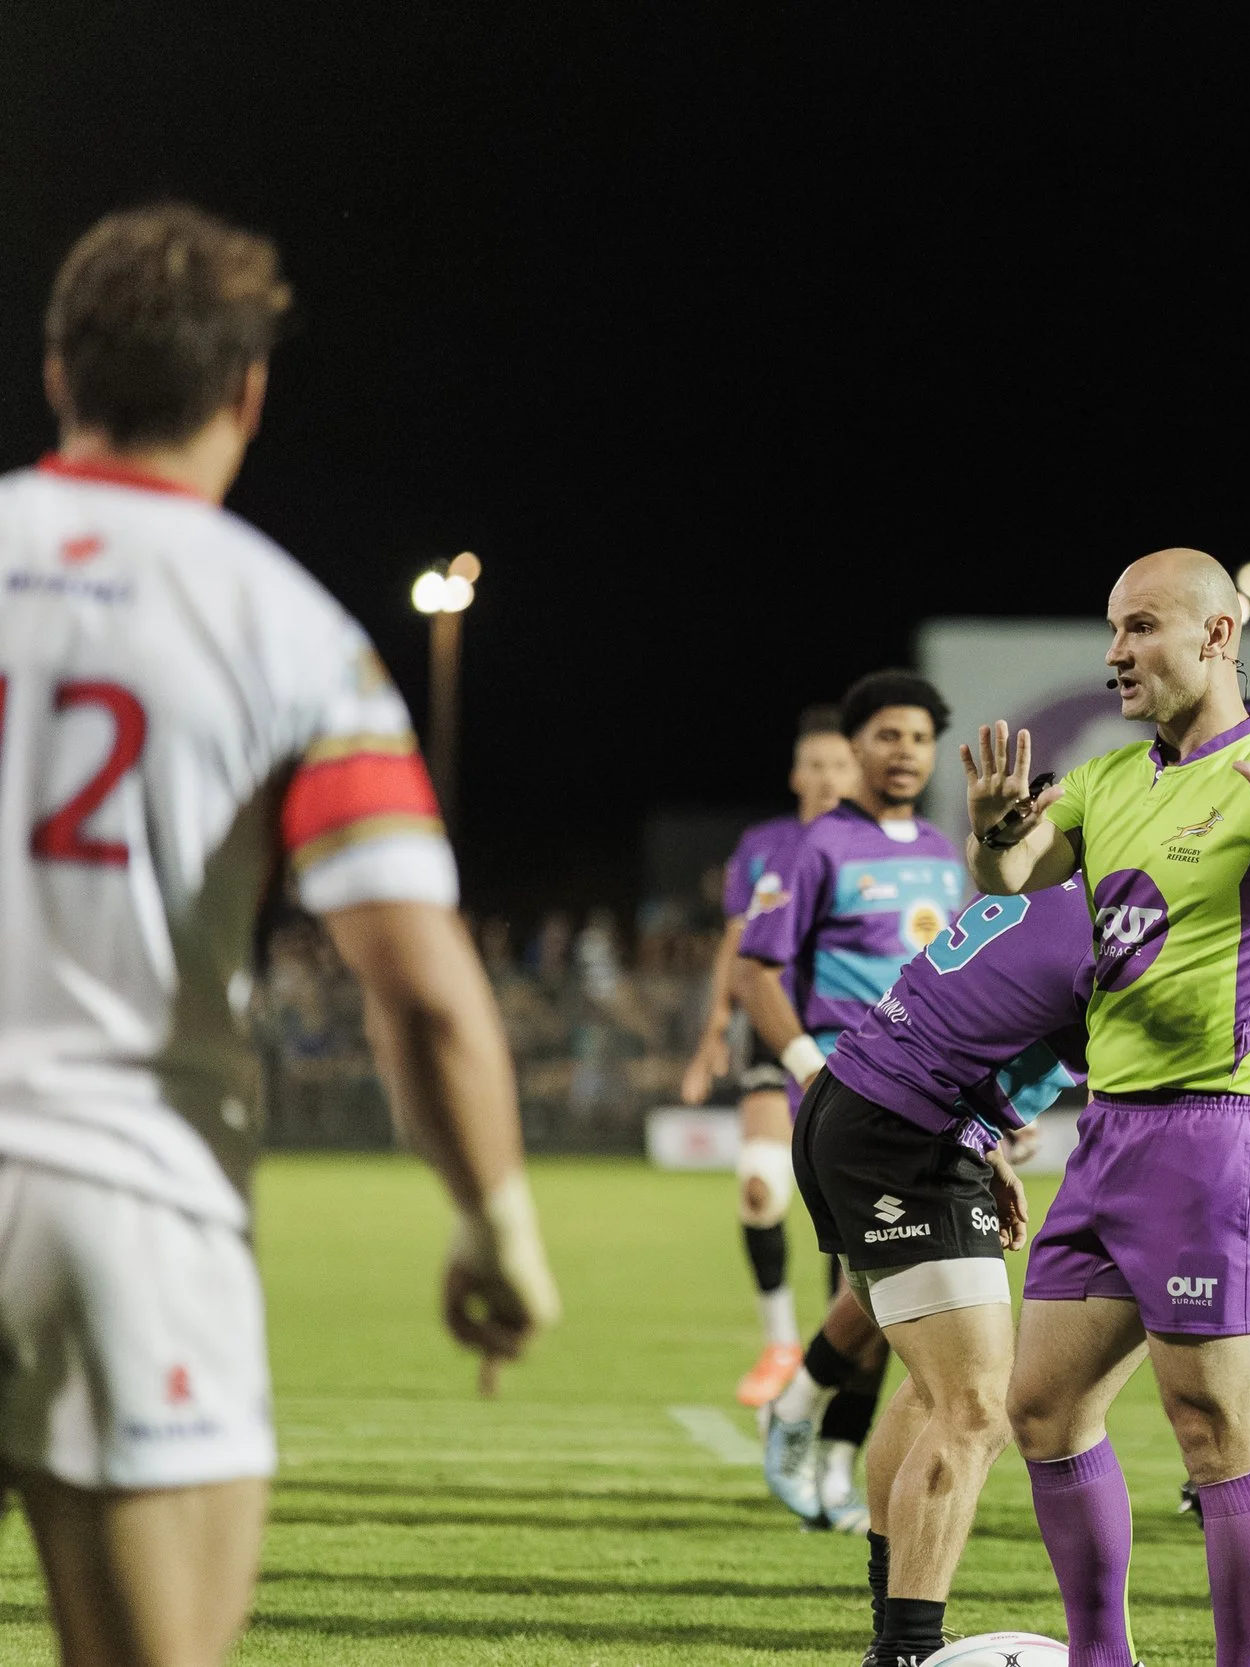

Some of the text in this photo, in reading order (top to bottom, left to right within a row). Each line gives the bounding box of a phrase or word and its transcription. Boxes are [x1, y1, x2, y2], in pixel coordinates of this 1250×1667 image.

[0, 671, 147, 865] 2
[1166, 853, 1200, 864] REFEREES
[1177, 847, 1201, 856] RUGBY
[1095, 904, 1163, 943] OUT
[925, 894, 1031, 975] 9
[1099, 944, 1142, 958] SURACE
[971, 1206, 1000, 1236] Spo
[864, 1223, 931, 1243] SUZUKI
[1166, 1276, 1218, 1298] OUT
[1171, 1298, 1213, 1307] SURANCE
